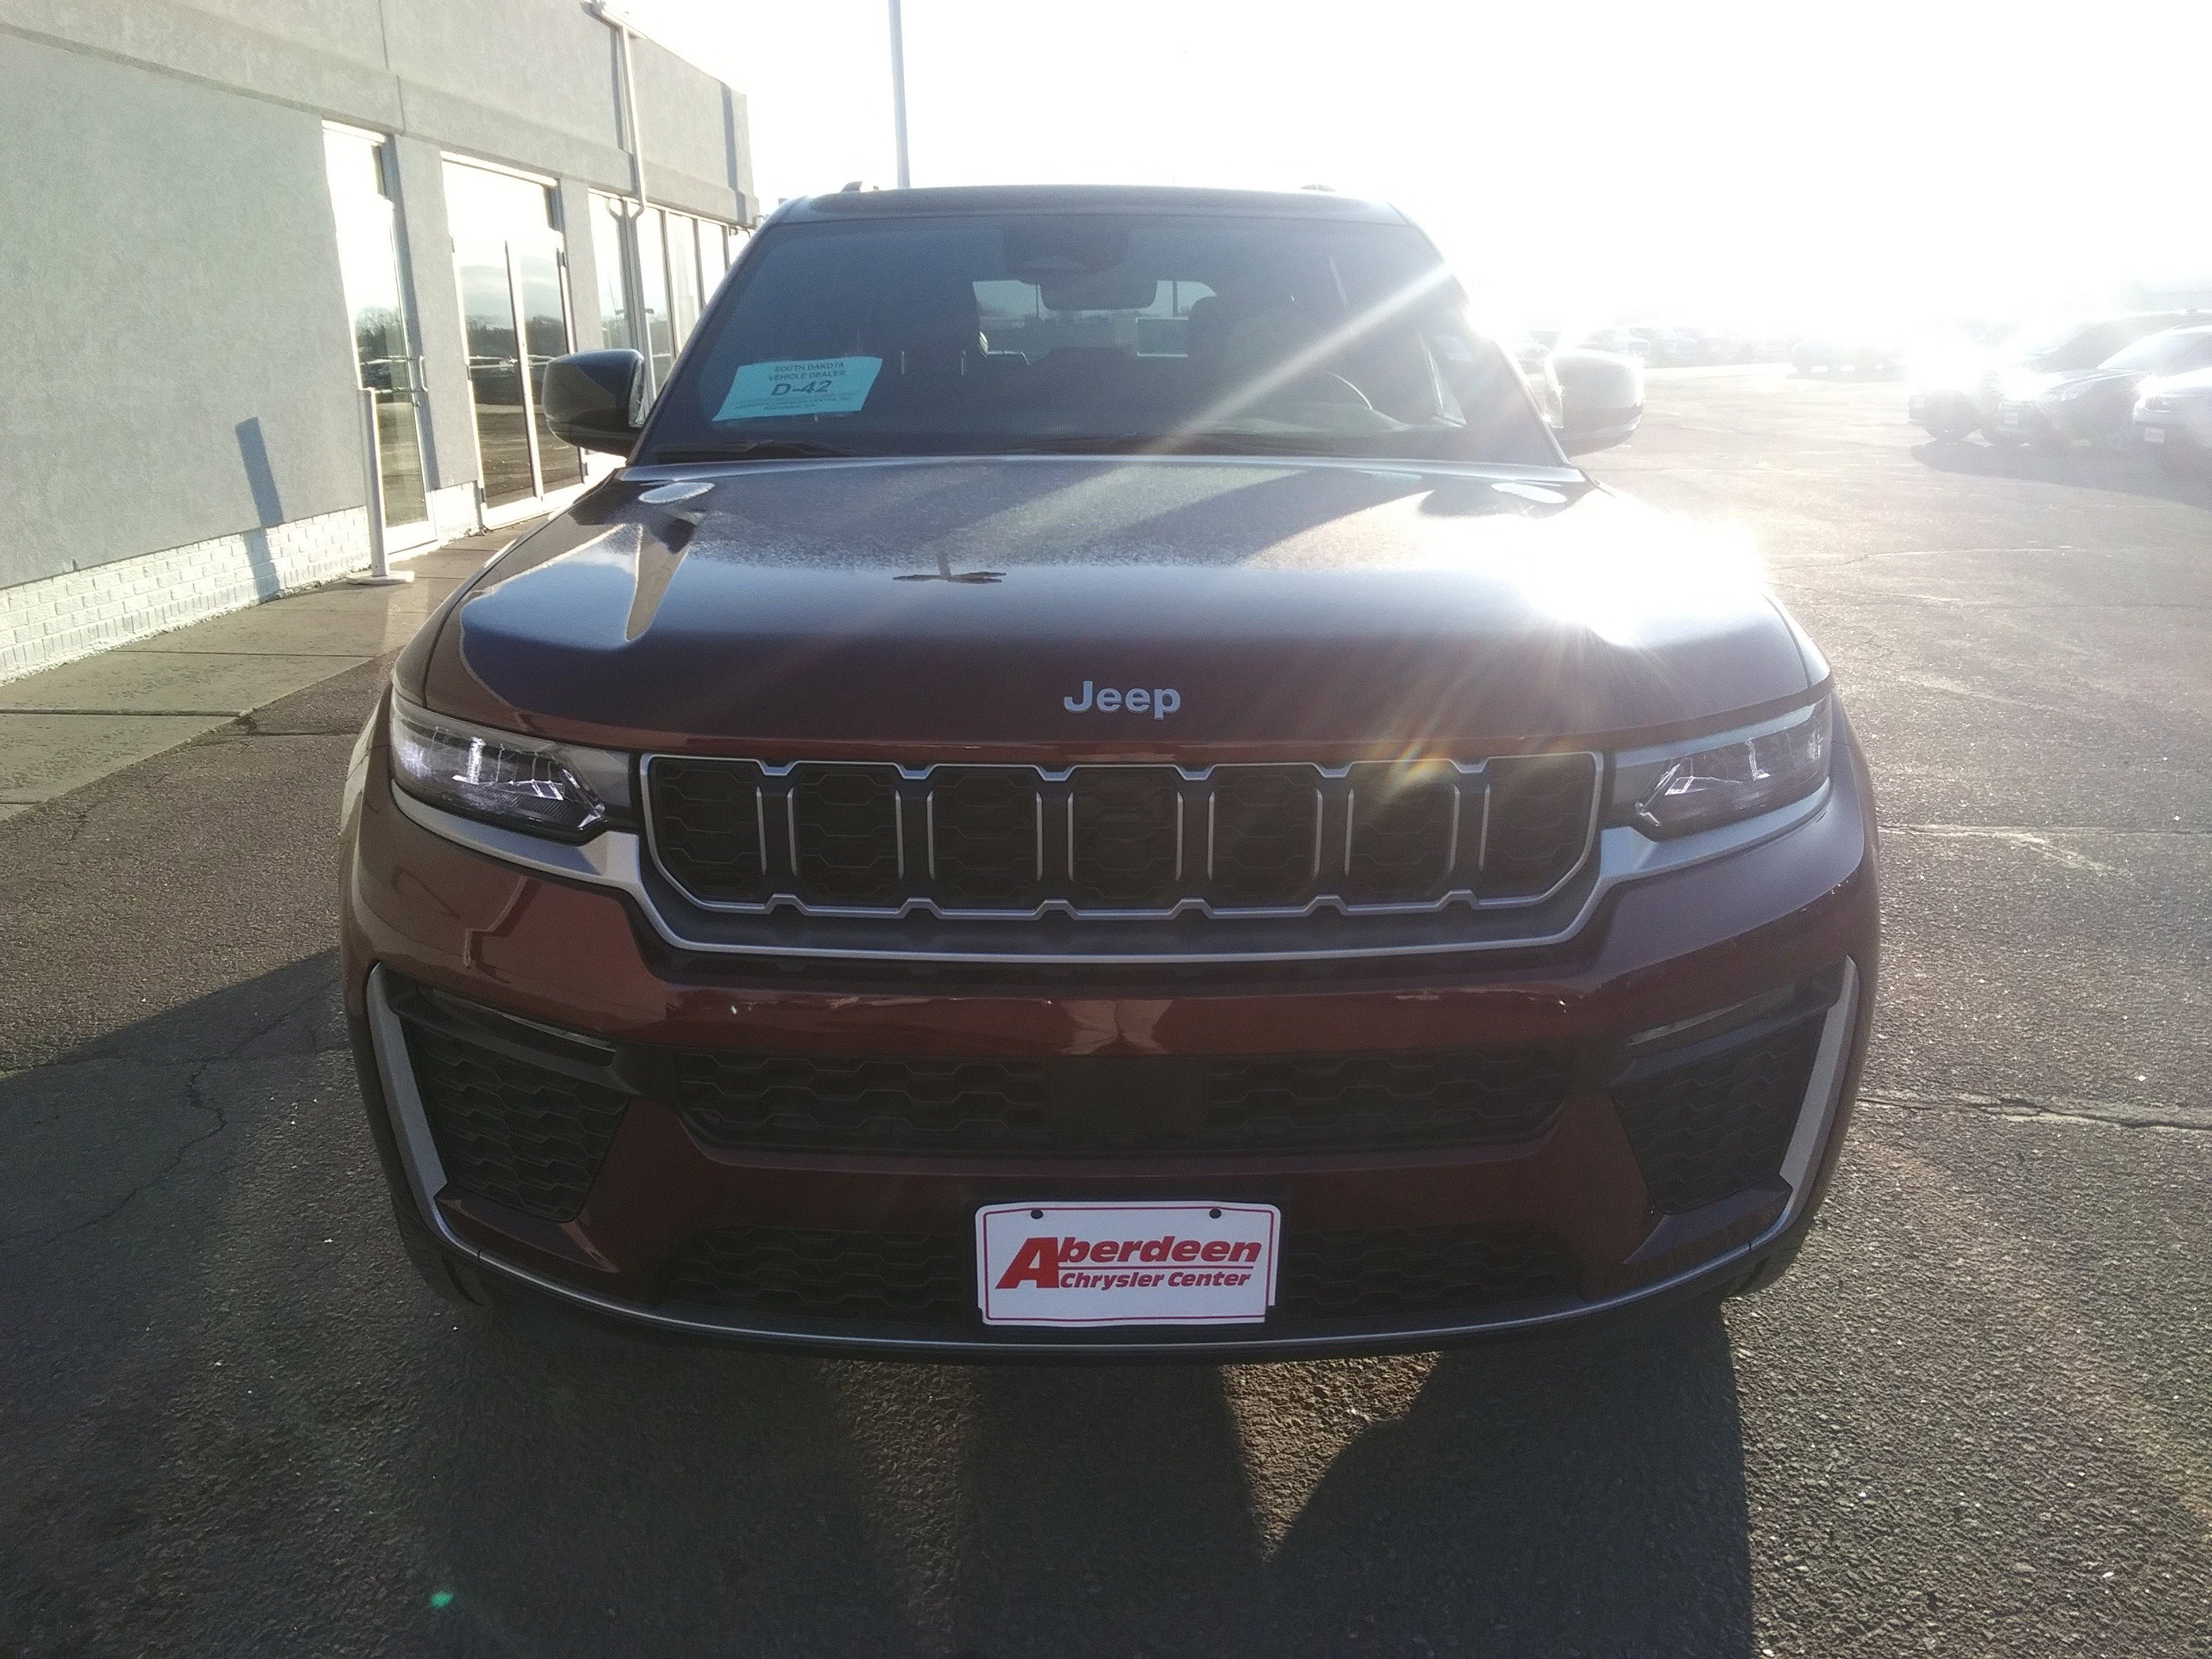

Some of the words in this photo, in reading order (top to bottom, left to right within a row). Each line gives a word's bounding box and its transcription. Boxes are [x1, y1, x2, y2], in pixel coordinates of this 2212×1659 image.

[768, 372, 806, 382] VEHICLE
[808, 369, 846, 380] DEALER
[773, 364, 805, 373] SOUTH
[806, 361, 844, 371] DAKOTA
[771, 380, 832, 396] D-42
[1063, 680, 1181, 720] Jeep
[995, 1235, 1262, 1289] Aberdeen
[1060, 1271, 1164, 1290] Chrysler
[1167, 1271, 1251, 1288] Center
